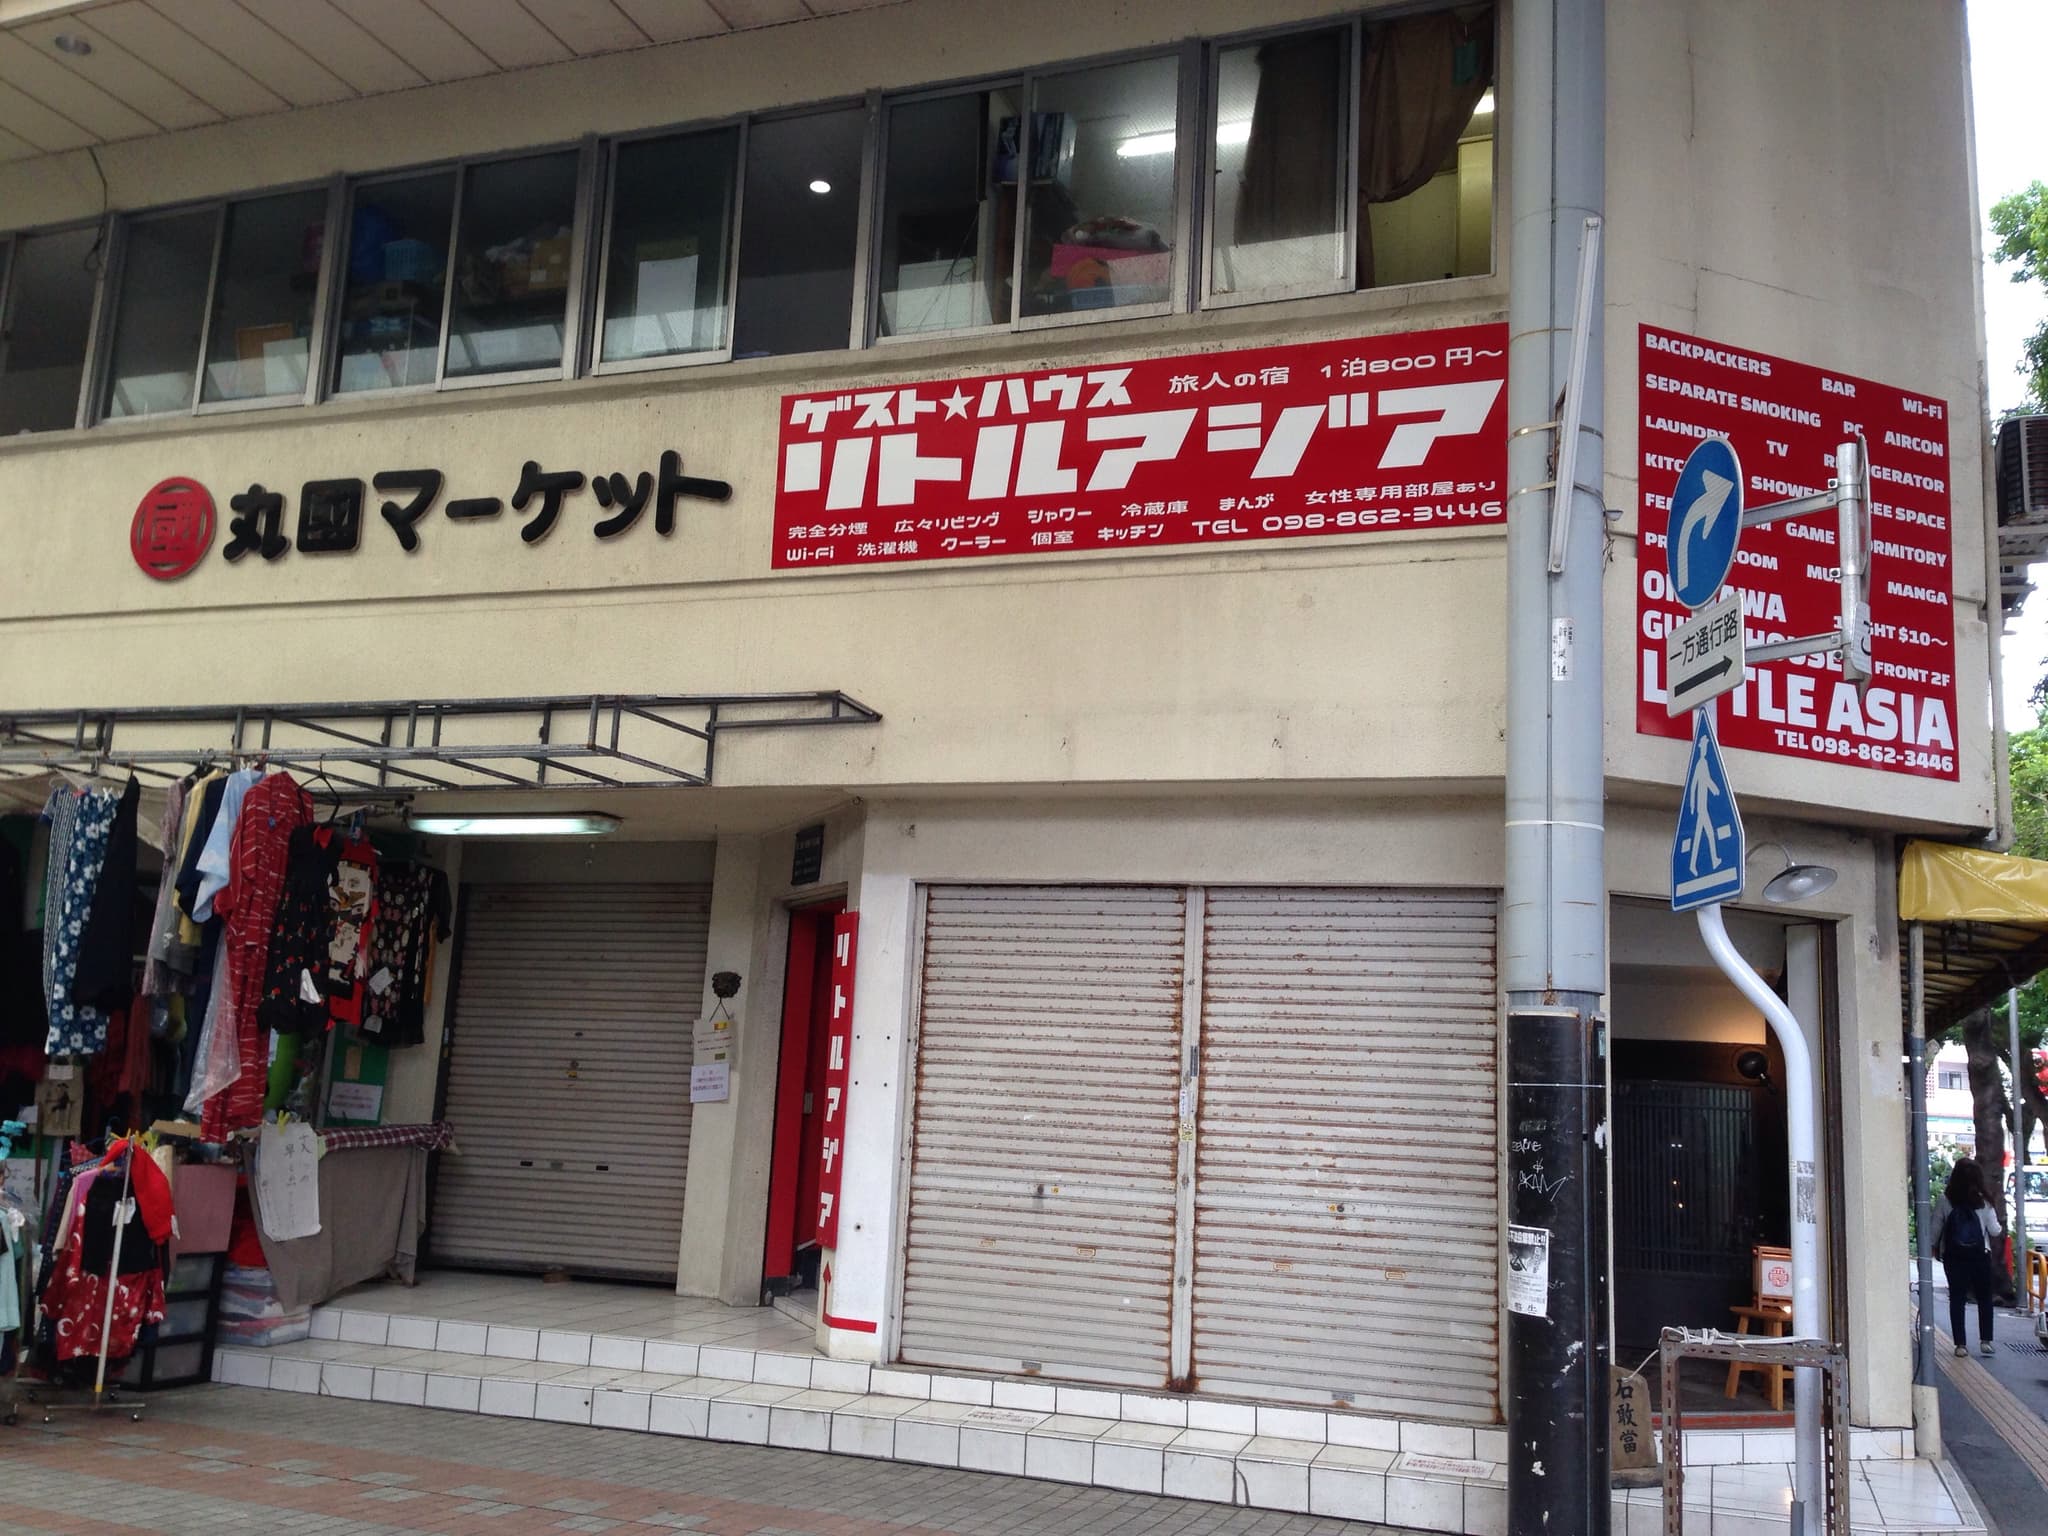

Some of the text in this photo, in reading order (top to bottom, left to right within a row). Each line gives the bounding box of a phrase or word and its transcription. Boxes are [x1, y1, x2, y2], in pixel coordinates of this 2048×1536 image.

[1646, 334, 1771, 376] BACKPACKERS
[1169, 366, 1290, 394] 旅人の宿
[1822, 378, 1856, 398] BAR
[1646, 374, 1821, 427] SEPARATE SMOKING
[1902, 397, 1943, 420] Wi-Fi
[1646, 415, 1730, 440] LAUNDRY
[1844, 421, 1863, 437] PC
[784, 379, 1504, 510] リトルアジア
[1766, 440, 1790, 457] TV
[1884, 430, 1944, 457] AIRCON
[1645, 453, 1685, 473] KITC
[788, 480, 1497, 539] 完全分煙 広々リビング シャワー 冷蔵庫 まんが 女性専用部屋あり
[1895, 507, 1946, 530] SPACE
[786, 501, 1503, 561] Wi-Fi 洗濯機 クーラー 個室 キッチン TEL 098-862-3446
[1785, 522, 1836, 545] GAME
[1733, 550, 1779, 571] OOM
[1871, 539, 1947, 568] RMITORY
[1887, 581, 1948, 606] MANGA
[1670, 609, 1739, 666] 一方通行路
[1874, 660, 1951, 687] FRONT 2F
[1643, 648, 1954, 751] LTLE ASIA
[1774, 729, 1954, 773] TEL 098-862-3446
[818, 932, 851, 1229] リトルアジア
